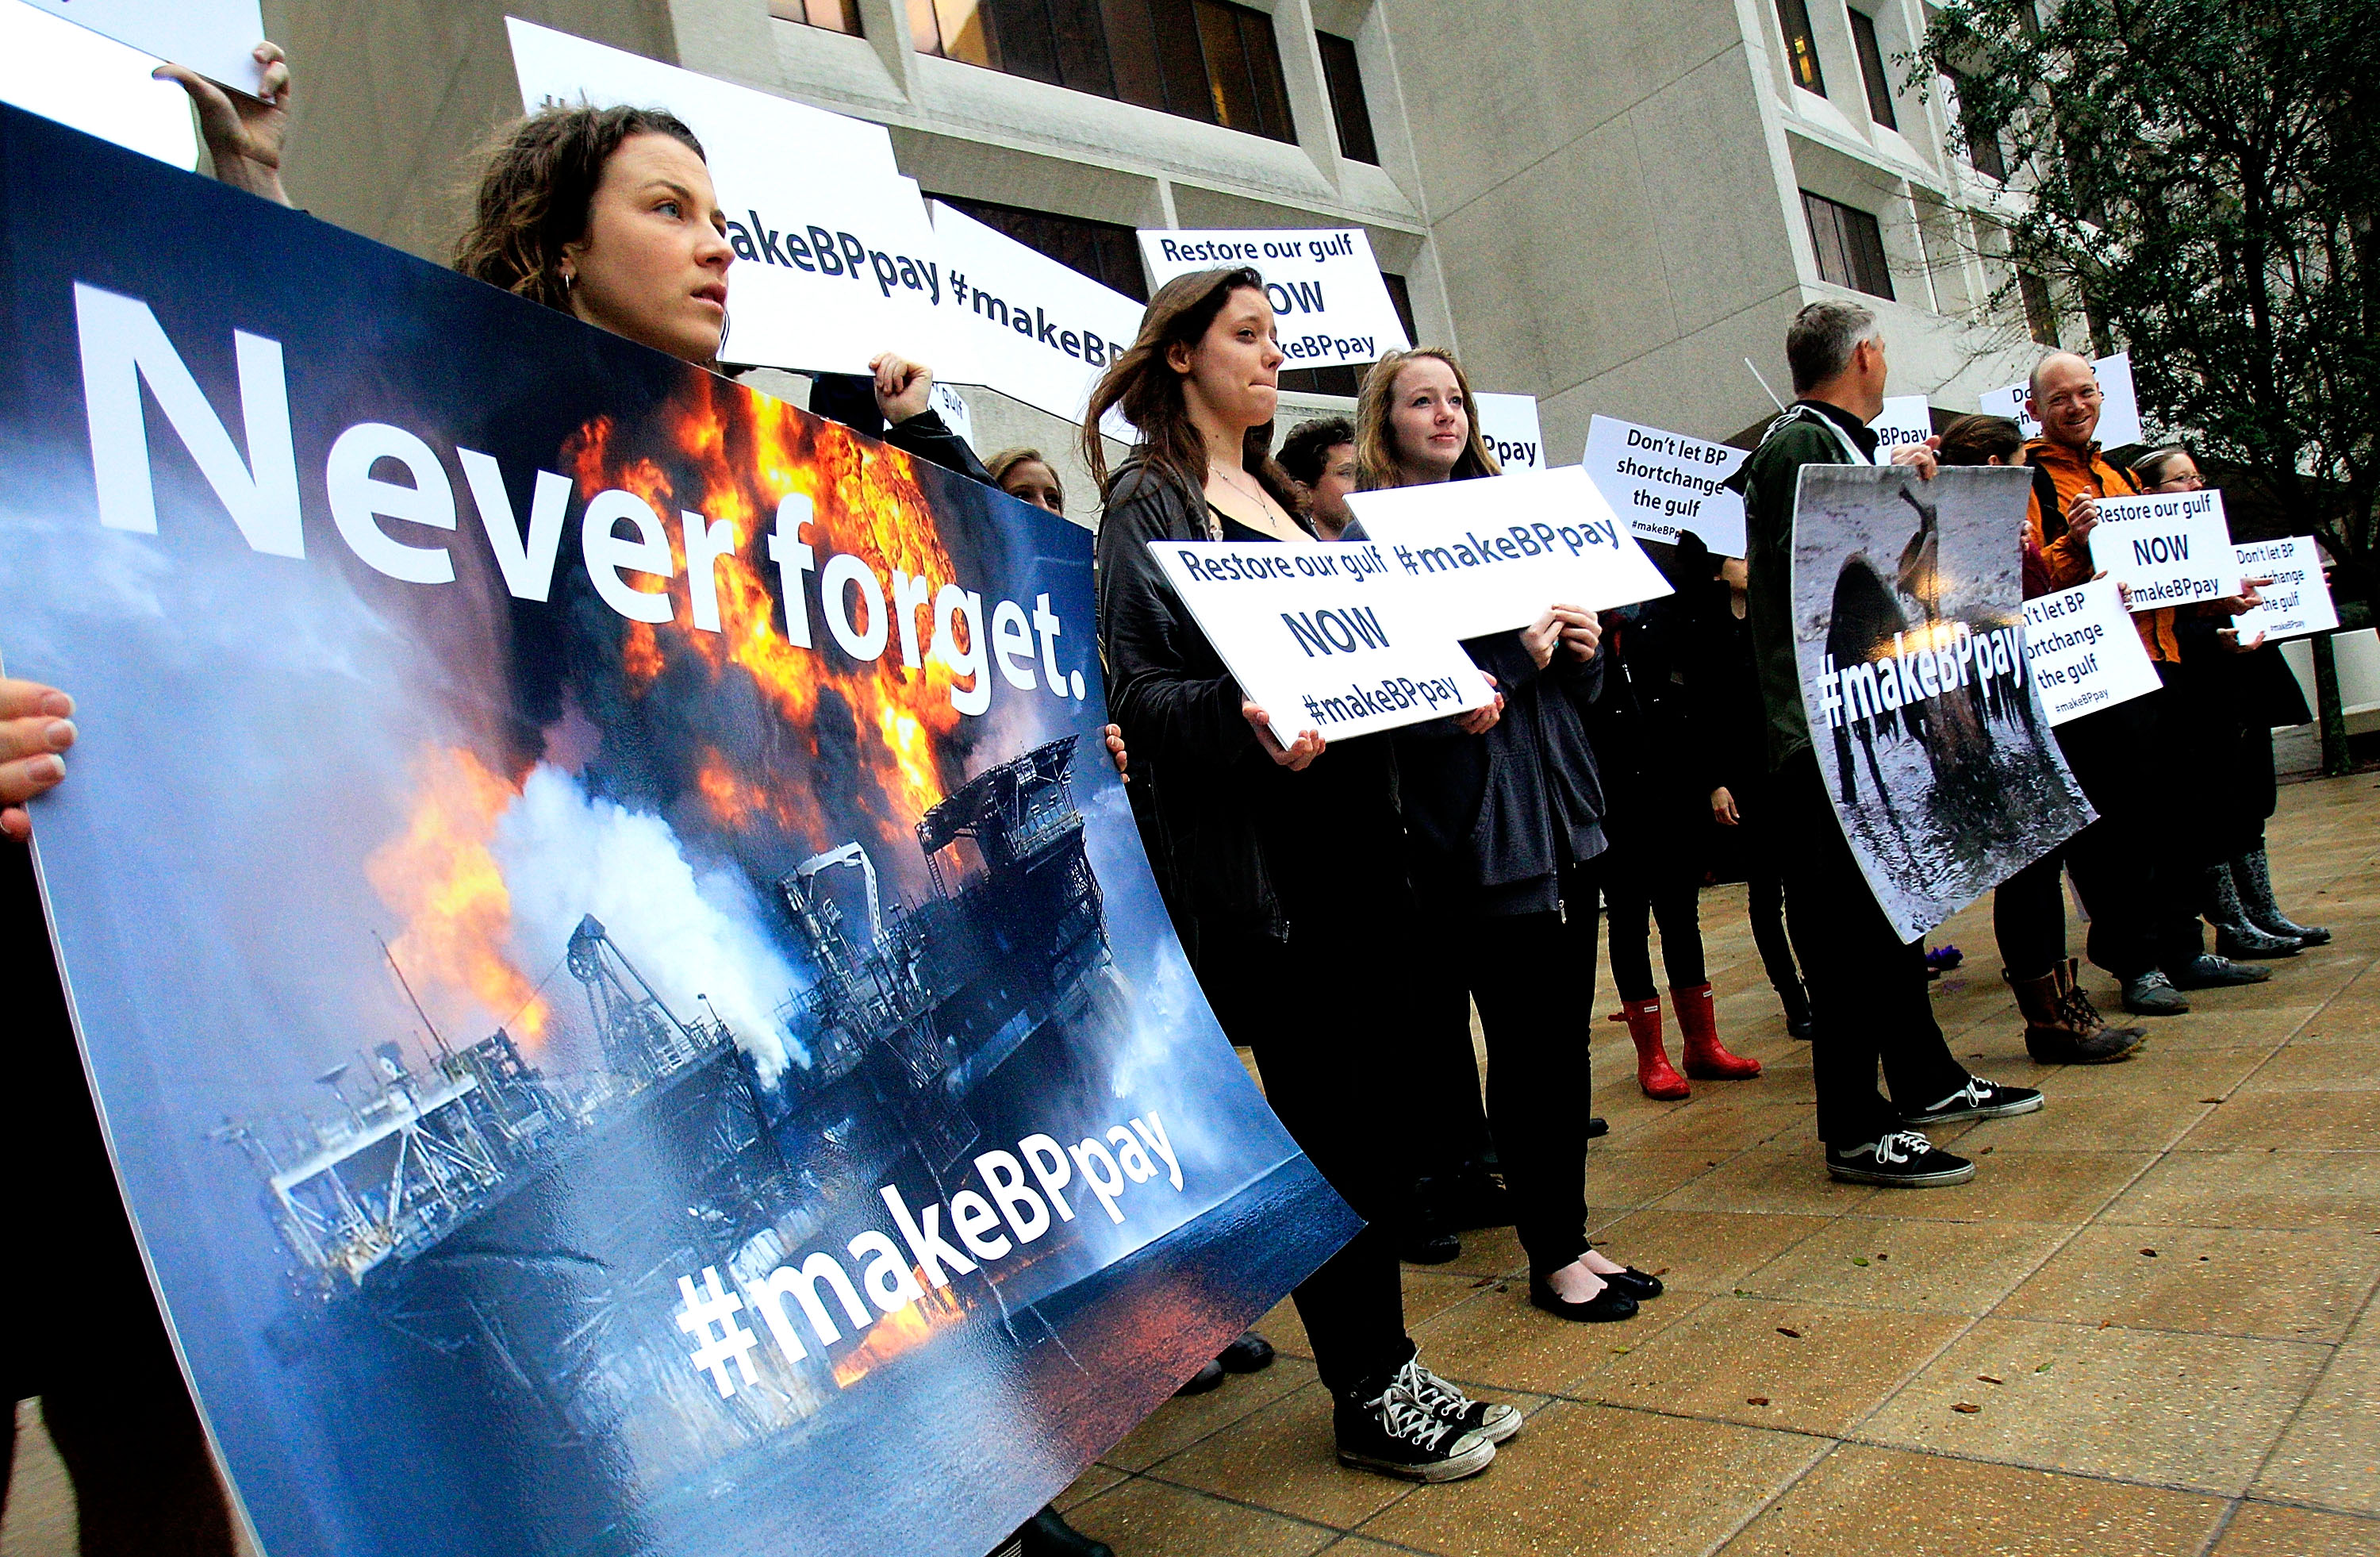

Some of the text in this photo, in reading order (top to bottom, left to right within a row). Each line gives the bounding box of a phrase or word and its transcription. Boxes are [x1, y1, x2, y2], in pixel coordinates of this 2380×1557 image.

[727, 210, 939, 306] akeBPpay
[1161, 233, 1353, 263] Restore our gulf
[1266, 281, 1325, 315] OW
[950, 270, 1126, 367] #makeBP
[1627, 429, 1728, 466] Don't let BP
[1880, 427, 1927, 446] BPpay
[1617, 457, 1726, 497] shortchange
[74, 282, 1085, 716] Never forget.
[1633, 489, 1701, 517] the gulf
[2096, 494, 2211, 523] Restore our gulf
[1632, 520, 1680, 539] #makeBPp
[1178, 544, 1388, 582] Restore our gulf
[1393, 519, 1620, 576] #makeBPpay
[2132, 534, 2189, 566] NOW
[2266, 545, 2281, 560] let
[2281, 543, 2294, 559] BP
[2023, 591, 2086, 625] n't let BP
[2133, 578, 2219, 603] makeBPpay
[2261, 590, 2301, 613] the gulf
[1280, 606, 1390, 657] NOW
[2026, 624, 2104, 659] ortchange
[1817, 621, 2022, 730] #makeBPpay
[2036, 652, 2099, 689] the gulf
[1303, 675, 1463, 725] #makeBPpay
[2055, 689, 2109, 713] #makeBPpay
[676, 1109, 1184, 1400] #makeBPpay
